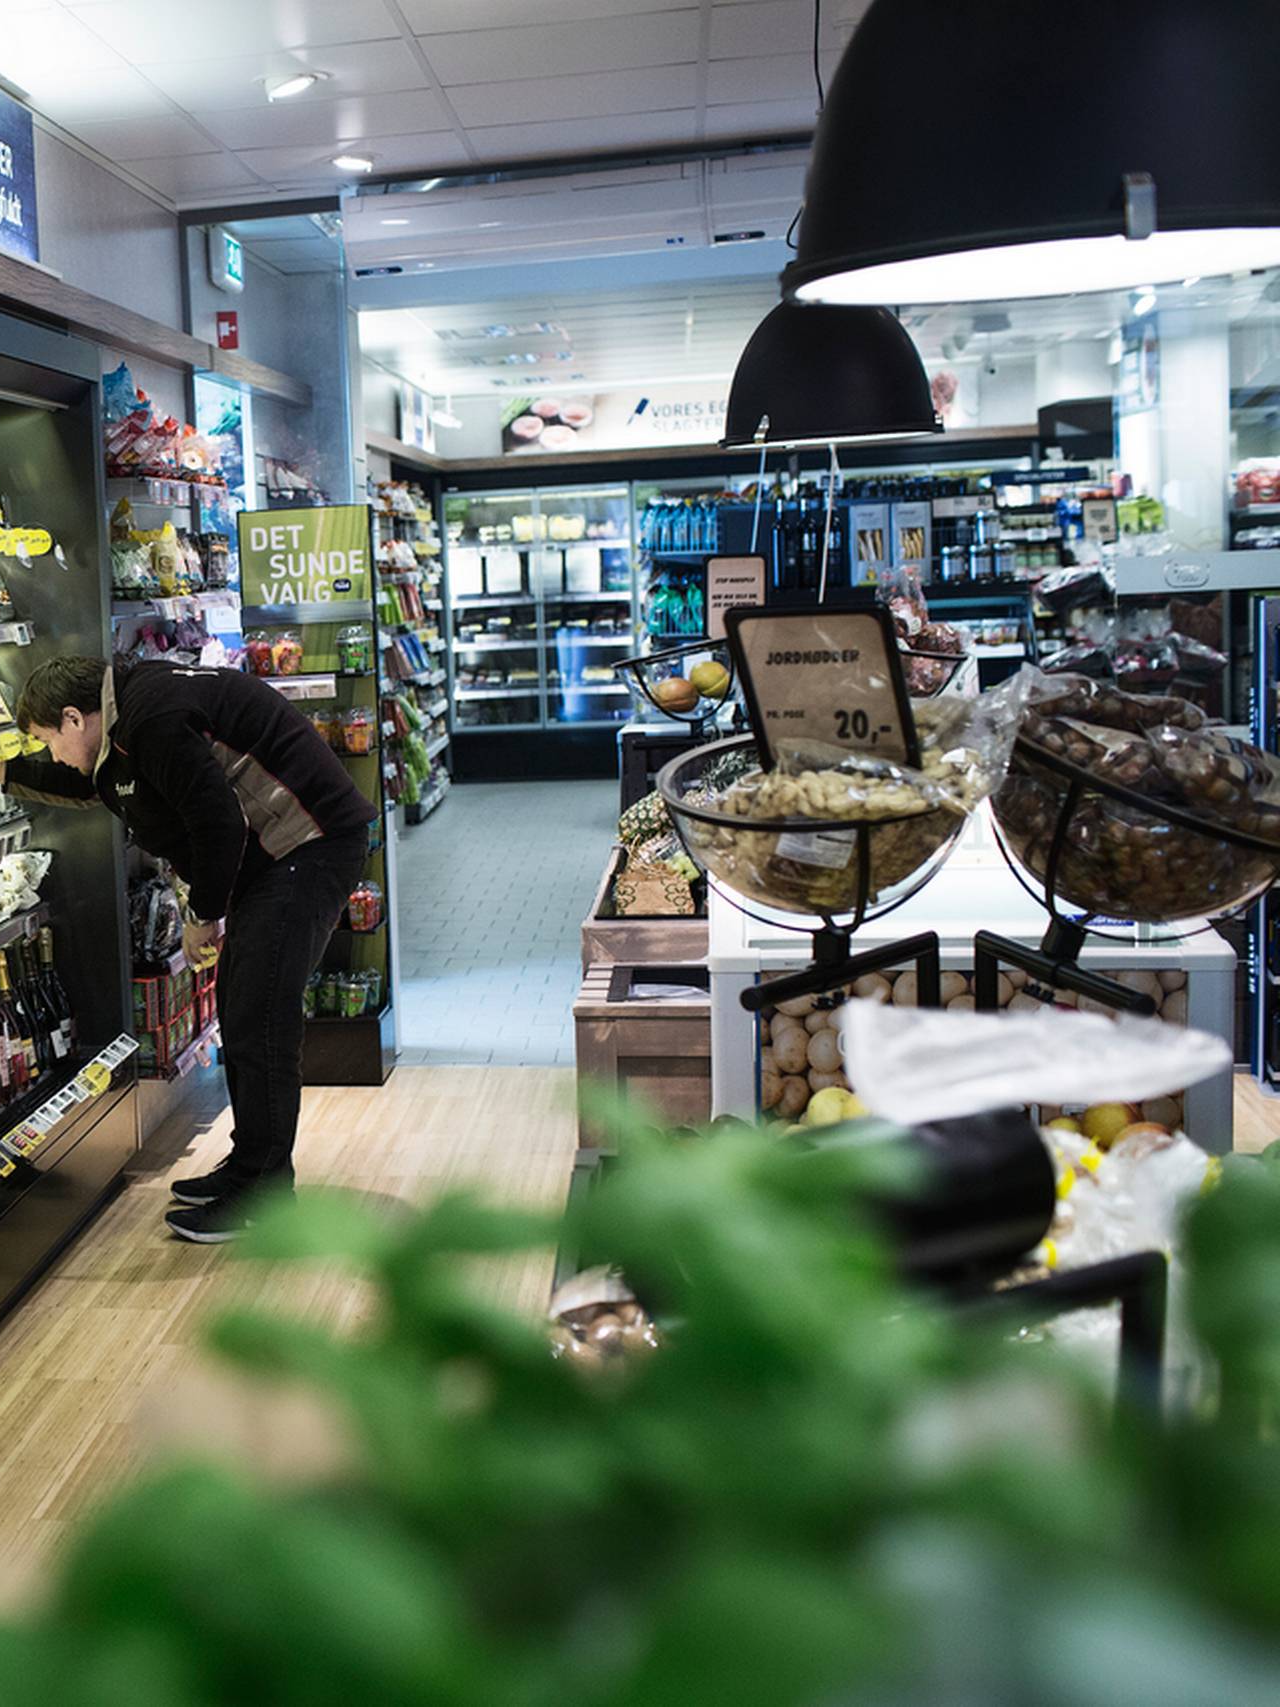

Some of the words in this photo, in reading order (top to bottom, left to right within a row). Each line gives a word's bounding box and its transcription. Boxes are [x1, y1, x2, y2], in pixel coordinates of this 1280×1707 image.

[651, 401, 704, 417] VORES
[250, 524, 304, 552] DET
[270, 550, 365, 579] SUNDE
[260, 580, 332, 605] VALG
[833, 708, 893, 744] 20,-
